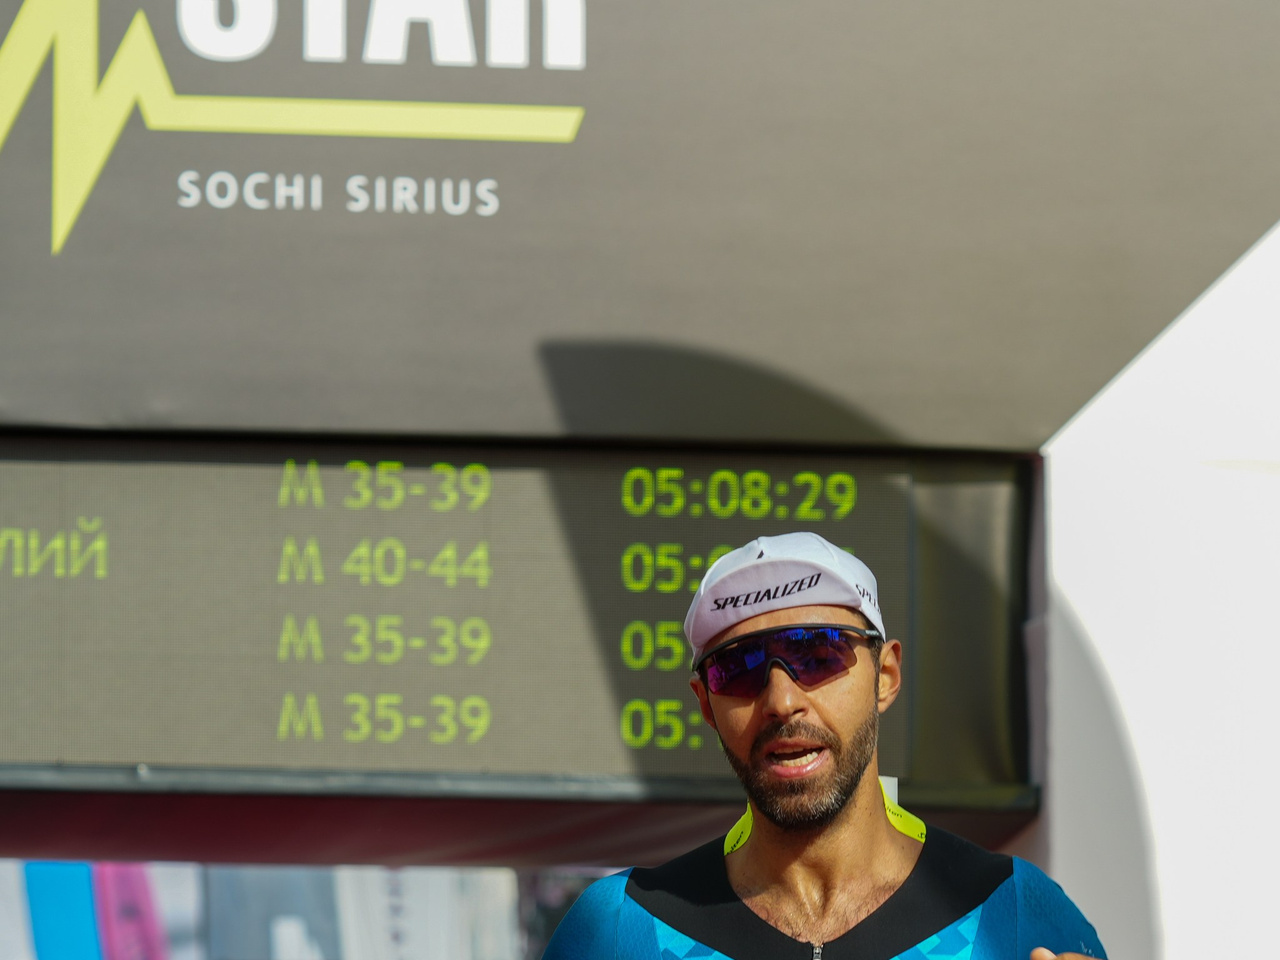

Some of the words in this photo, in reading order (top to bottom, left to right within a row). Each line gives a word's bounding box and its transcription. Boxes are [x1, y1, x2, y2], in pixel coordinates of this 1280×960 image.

[176, 170, 323, 211] SOCHI
[346, 174, 500, 217] SIRIUS
[342, 460, 492, 512] 35-39
[621, 467, 858, 521] 05:08:29
[341, 536, 492, 588] 40-44
[710, 572, 822, 612] SPECIALIZED
[342, 613, 492, 666] 35-39
[342, 692, 492, 744] 35-39
